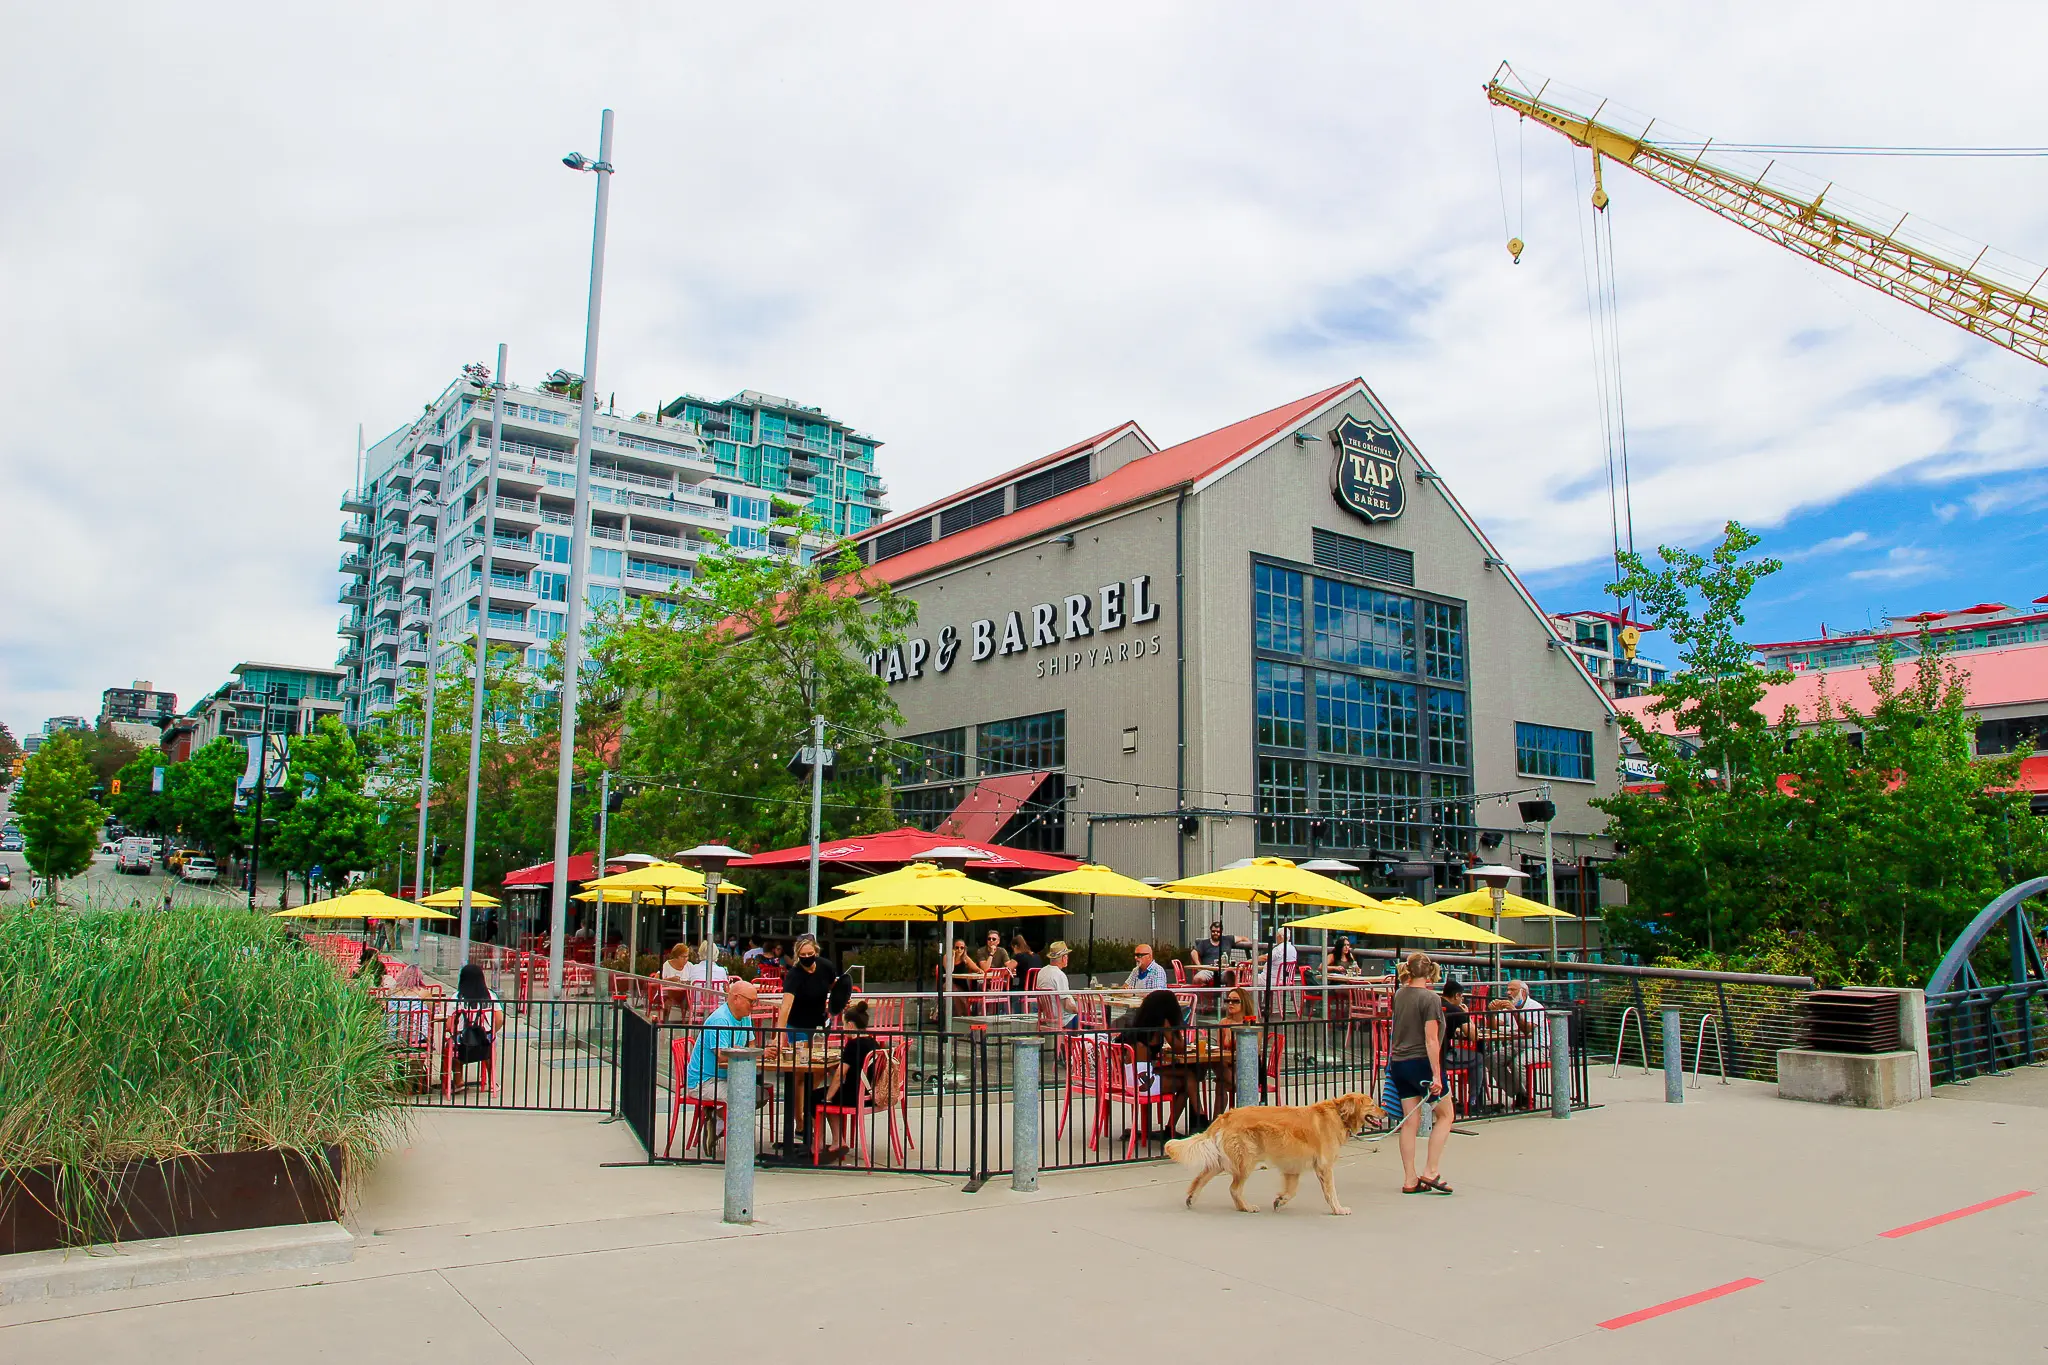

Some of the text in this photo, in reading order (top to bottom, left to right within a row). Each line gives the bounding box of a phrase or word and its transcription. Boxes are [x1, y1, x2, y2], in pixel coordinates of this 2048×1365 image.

[1348, 437, 1392, 457] THE ORIGINAL
[1349, 454, 1394, 489] TAP
[1354, 492, 1391, 511] BARREL
[1369, 486, 1375, 496] &
[865, 575, 1160, 683] TAP & BARREL
[1037, 635, 1160, 678] SHIPYARDS
